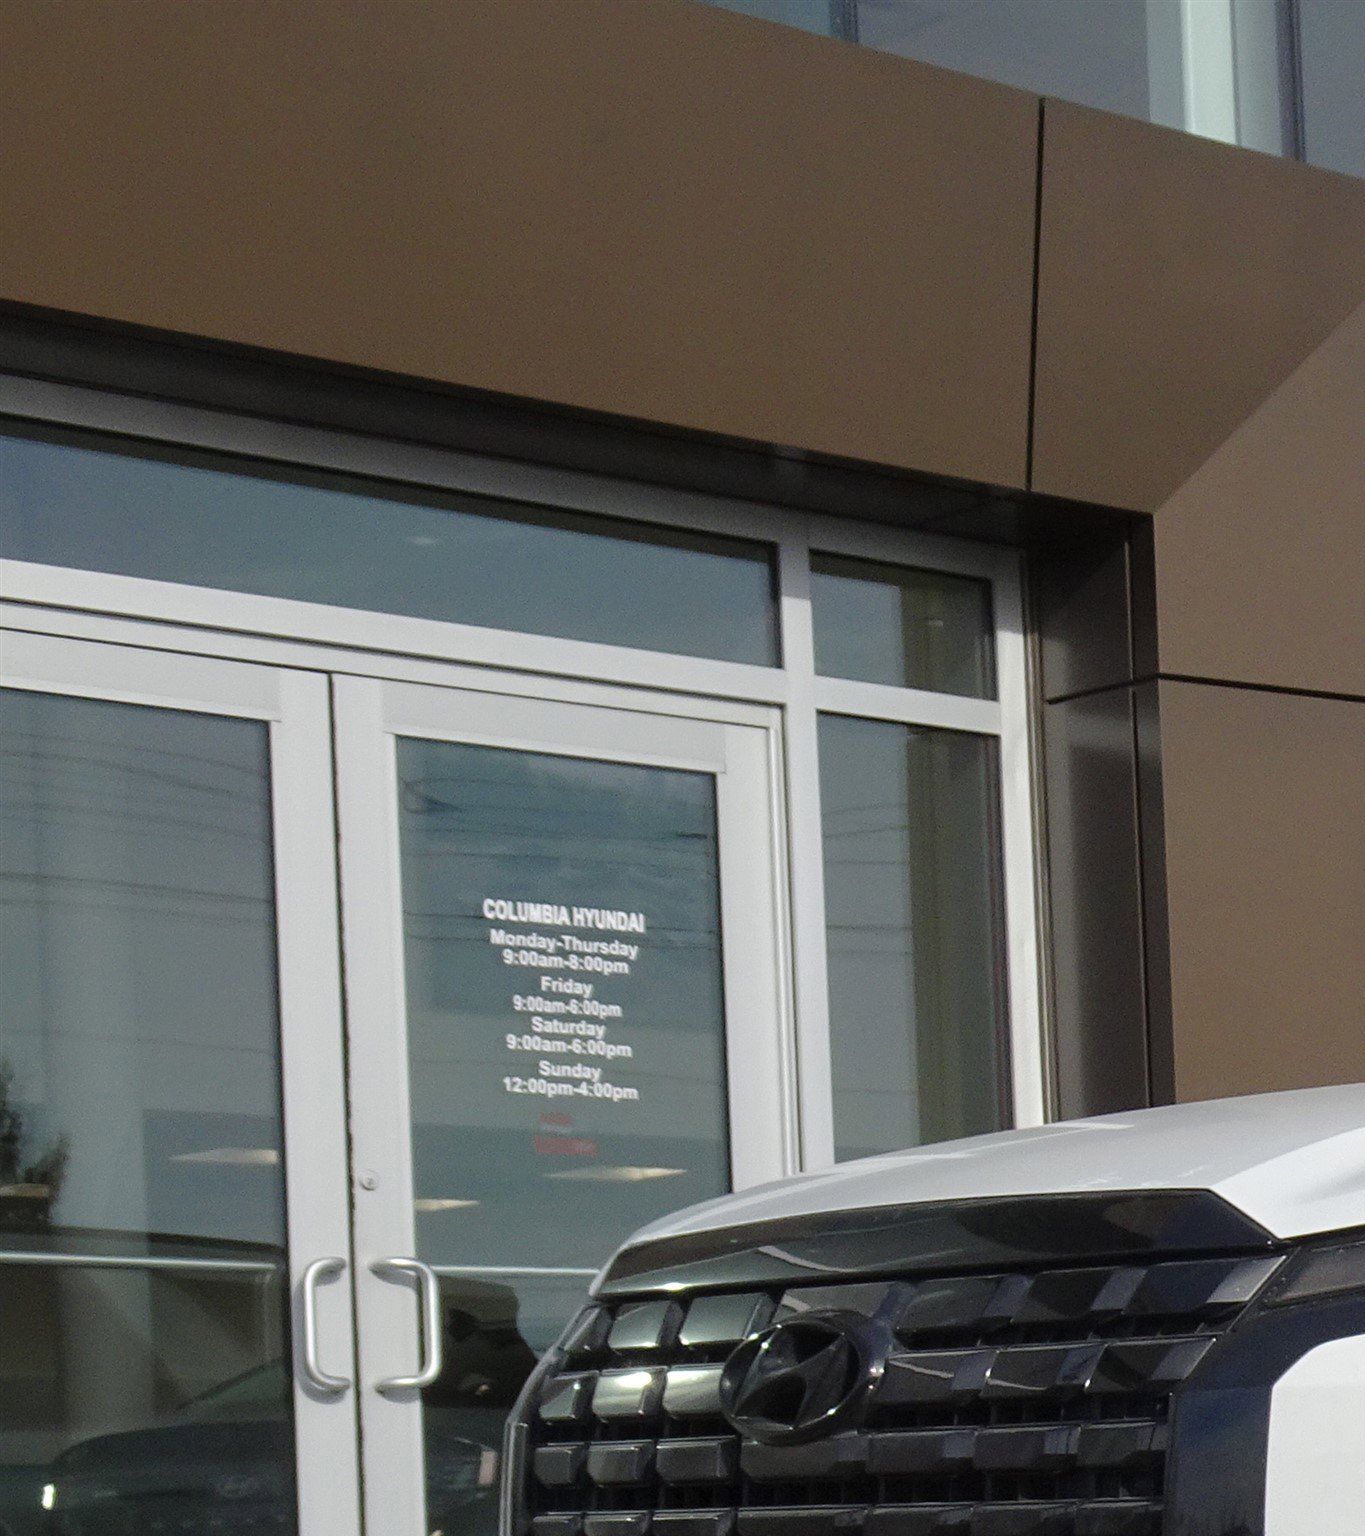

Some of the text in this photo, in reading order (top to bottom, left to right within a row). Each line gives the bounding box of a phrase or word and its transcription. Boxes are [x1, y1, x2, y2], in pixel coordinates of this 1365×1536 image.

[483, 899, 645, 933] COLUMBIA HYUNDAI
[490, 929, 638, 960] Monday-Thursday
[503, 949, 629, 975] 9:00am-8:00pm
[540, 976, 593, 998] Friday
[513, 995, 622, 1019] 9:00am-6:00pm
[531, 1016, 605, 1039] Saturday
[506, 1034, 632, 1059] 9:00am-6:00pm
[538, 1060, 601, 1082] Sunday
[503, 1077, 638, 1101] 12:00pm-4:00pm
